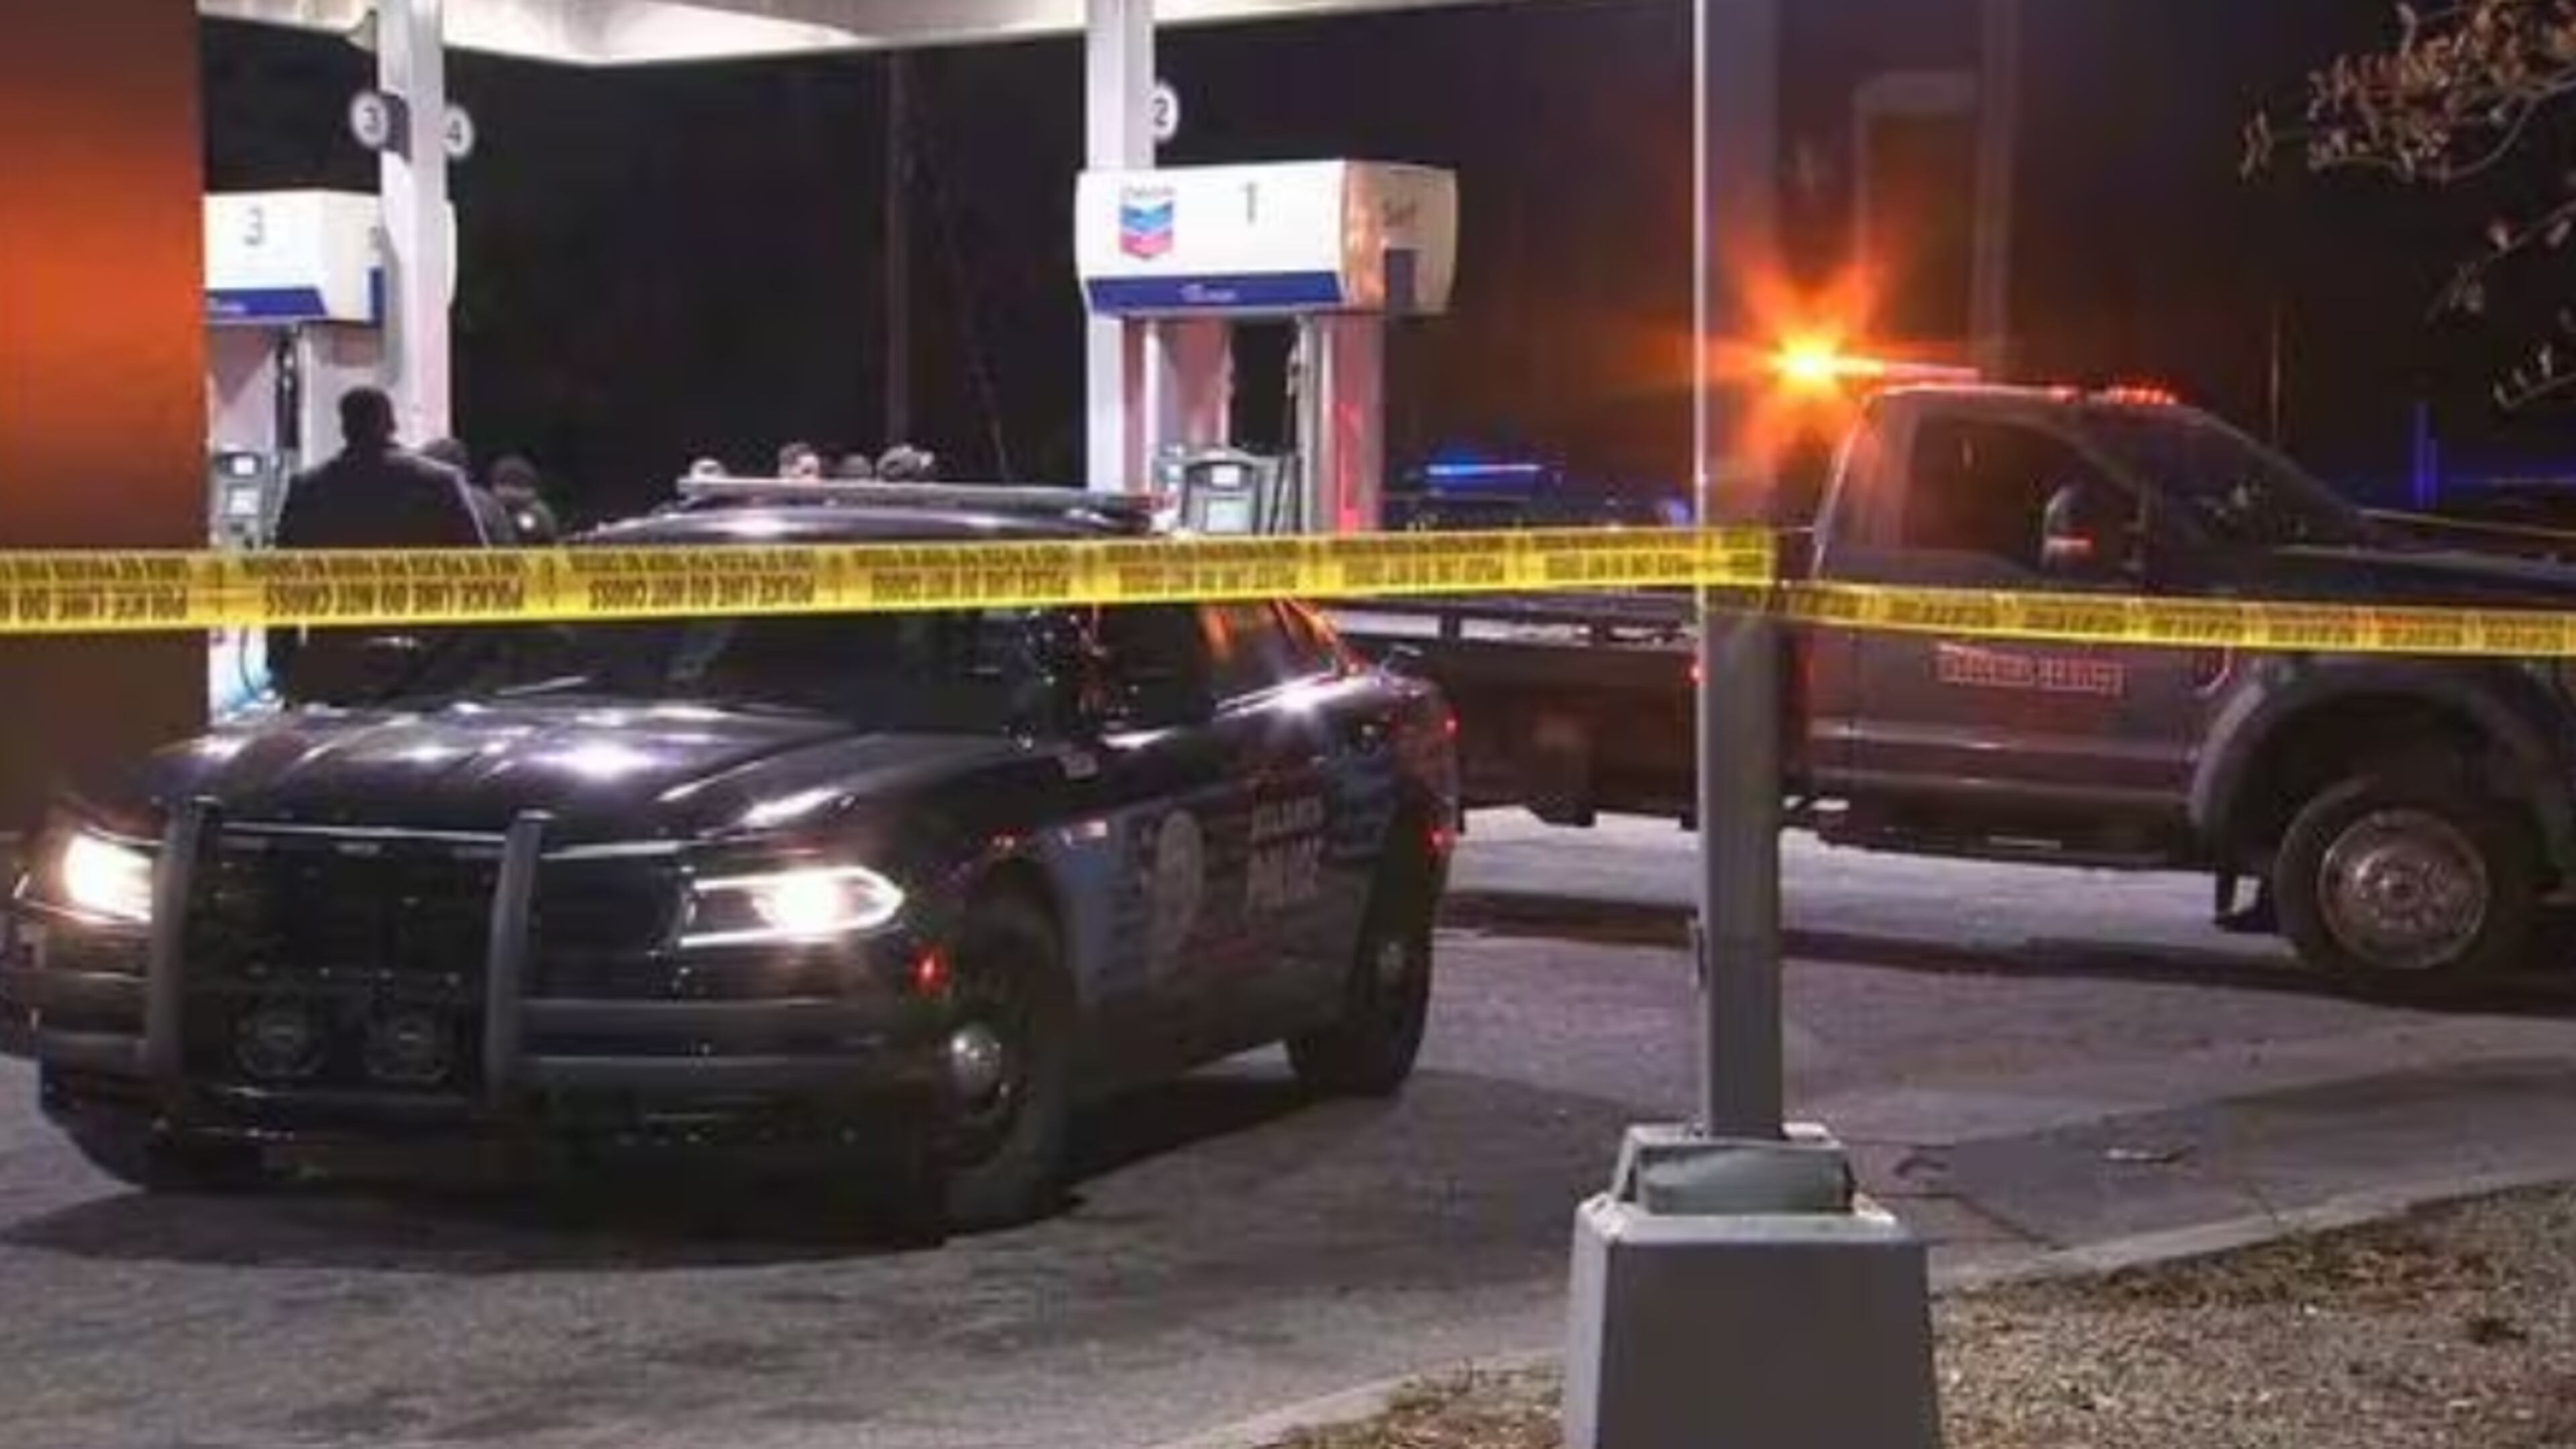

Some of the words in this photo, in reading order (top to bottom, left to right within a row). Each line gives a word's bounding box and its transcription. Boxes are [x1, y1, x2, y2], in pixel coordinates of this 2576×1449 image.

[364, 105, 381, 135] 3
[1152, 97, 1169, 127] 2
[445, 119, 462, 147] 4
[1241, 182, 1260, 224] 1
[244, 206, 266, 247] 3
[18, 588, 51, 622] DO
[57, 588, 106, 622] LINE
[111, 587, 189, 622] POLICE
[264, 584, 333, 617] CROSS
[335, 583, 374, 616] NOT
[380, 583, 409, 615] DO
[411, 582, 454, 614] LINE
[461, 580, 523, 612] POLICE
[588, 579, 647, 610] CROSS
[649, 577, 685, 608] NOT
[717, 575, 753, 606] LINE
[757, 574, 814, 606] POLICE
